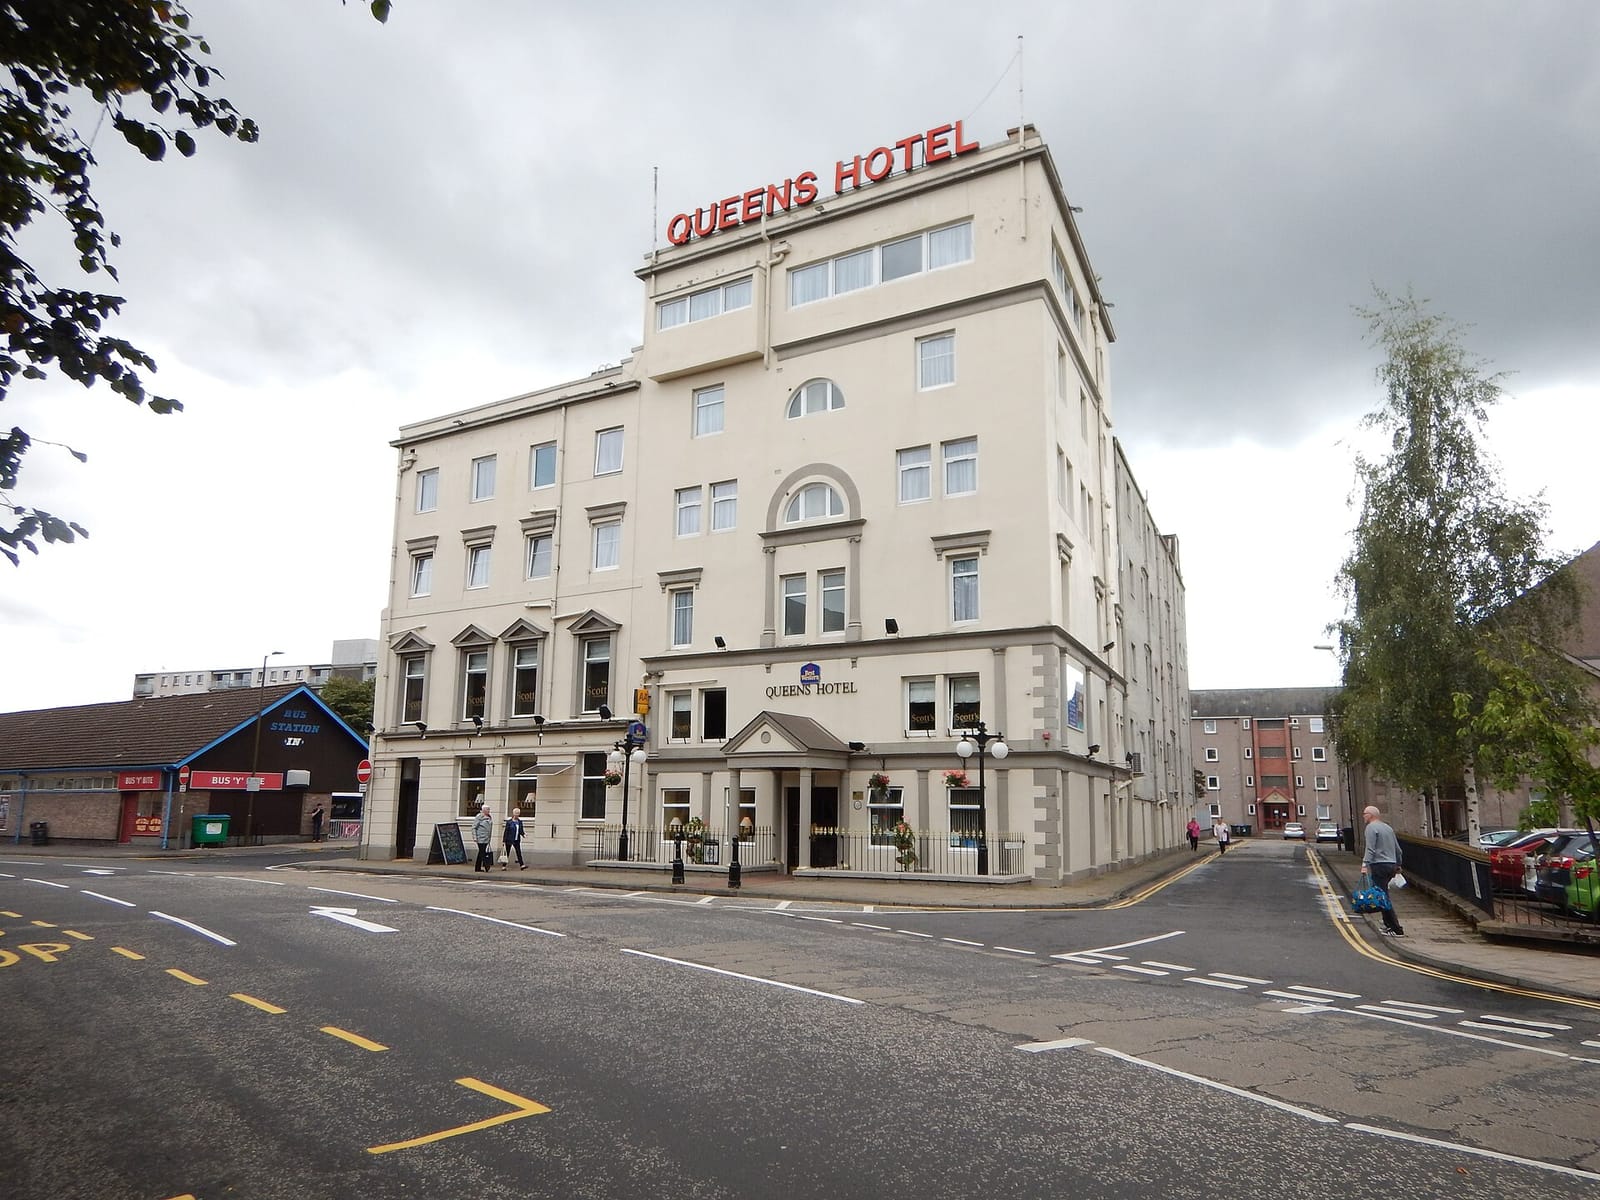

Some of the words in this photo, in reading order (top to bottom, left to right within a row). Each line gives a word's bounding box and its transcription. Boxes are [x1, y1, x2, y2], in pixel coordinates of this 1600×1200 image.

[667, 171, 818, 246] QUEENS
[835, 119, 980, 194] HOTEL
[766, 684, 811, 700] QUEENS
[816, 682, 858, 696] HOTEL
[284, 710, 307, 719] BUS
[955, 712, 980, 722] Scott's
[270, 723, 320, 734] STATION
[212, 777, 230, 785] BUS
